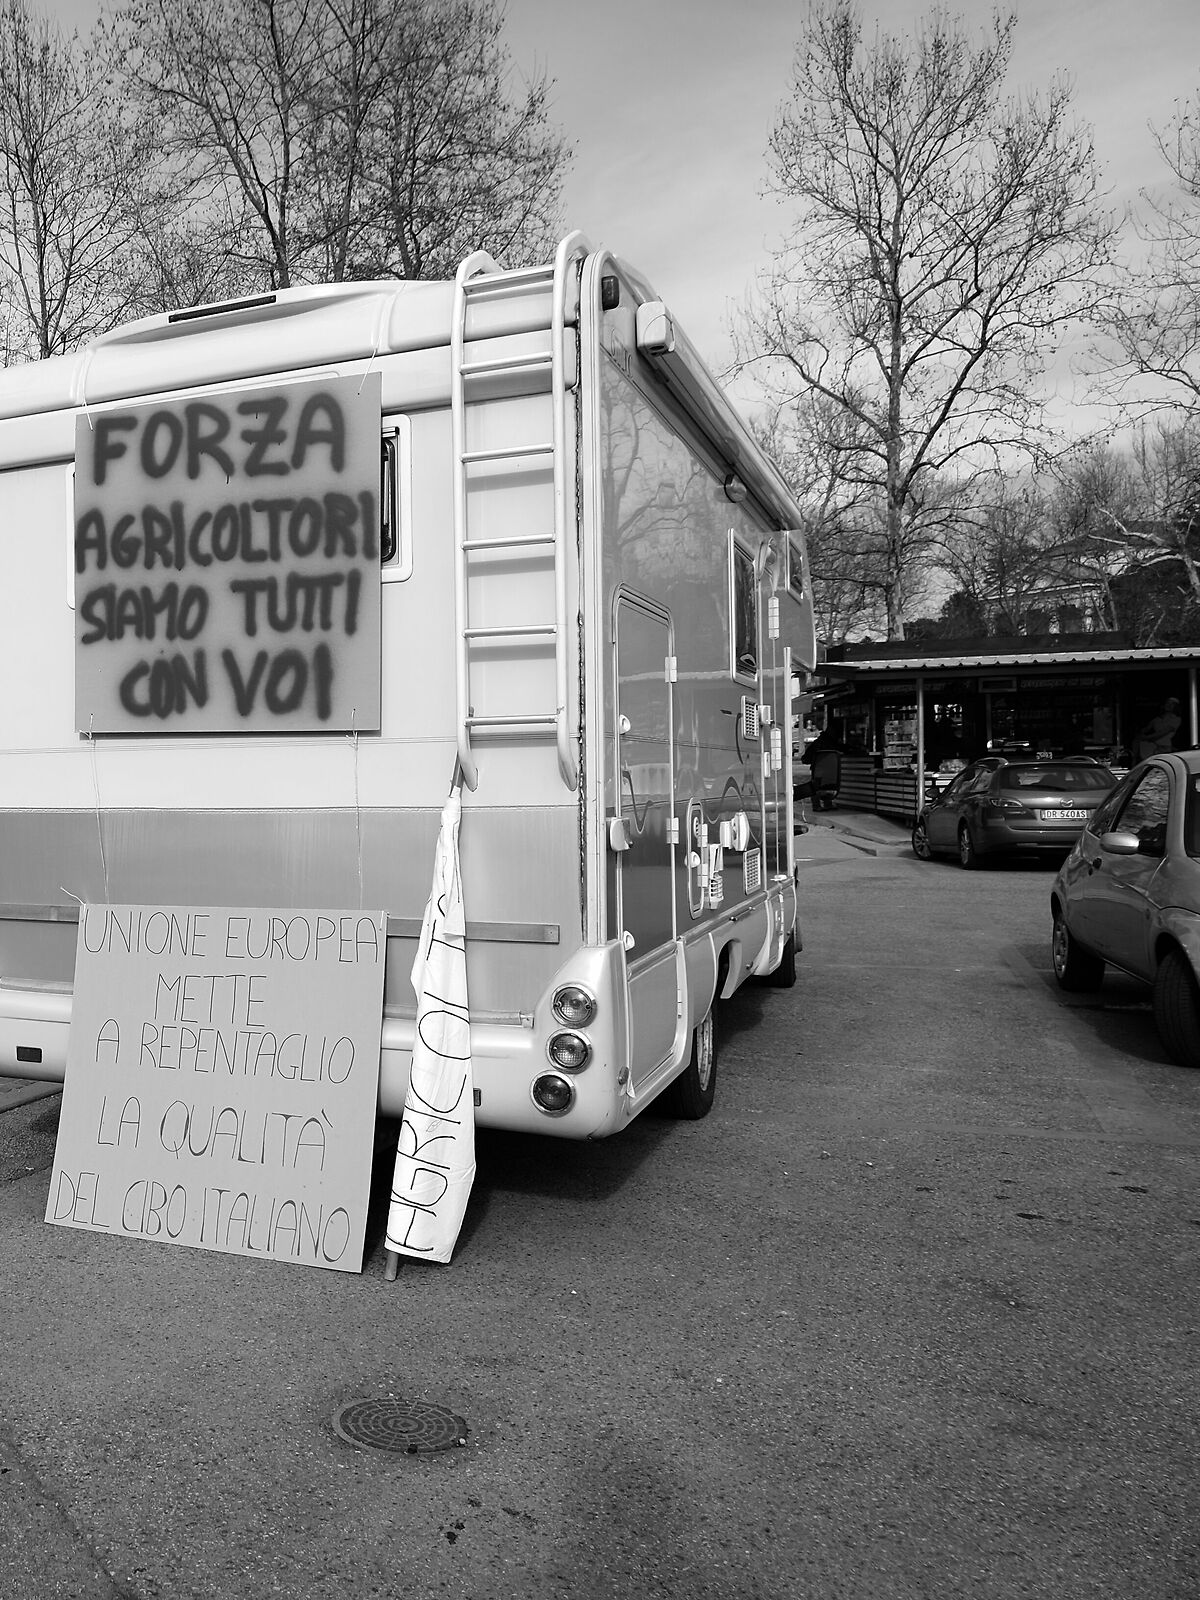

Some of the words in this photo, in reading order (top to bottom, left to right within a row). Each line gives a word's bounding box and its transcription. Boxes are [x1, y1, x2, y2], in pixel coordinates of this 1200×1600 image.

[92, 392, 346, 486] FORZA
[75, 490, 378, 574] AGRICOLTORI
[80, 581, 210, 645] SIAMO
[230, 568, 362, 638] TUTTI
[119, 648, 210, 720] CON
[221, 642, 334, 721] VOI
[84, 909, 210, 957] UNIONE
[225, 916, 378, 963] EUROPEA
[154, 973, 268, 1027] METTE
[96, 1018, 120, 1064] A
[139, 1022, 355, 1084] REPENTAGLIO
[97, 1096, 141, 1148] LA
[160, 1099, 334, 1172] QUALITÀ
[53, 1170, 110, 1228] DEL
[122, 1180, 187, 1239] CIBO
[200, 1187, 351, 1263] ITALIANO
